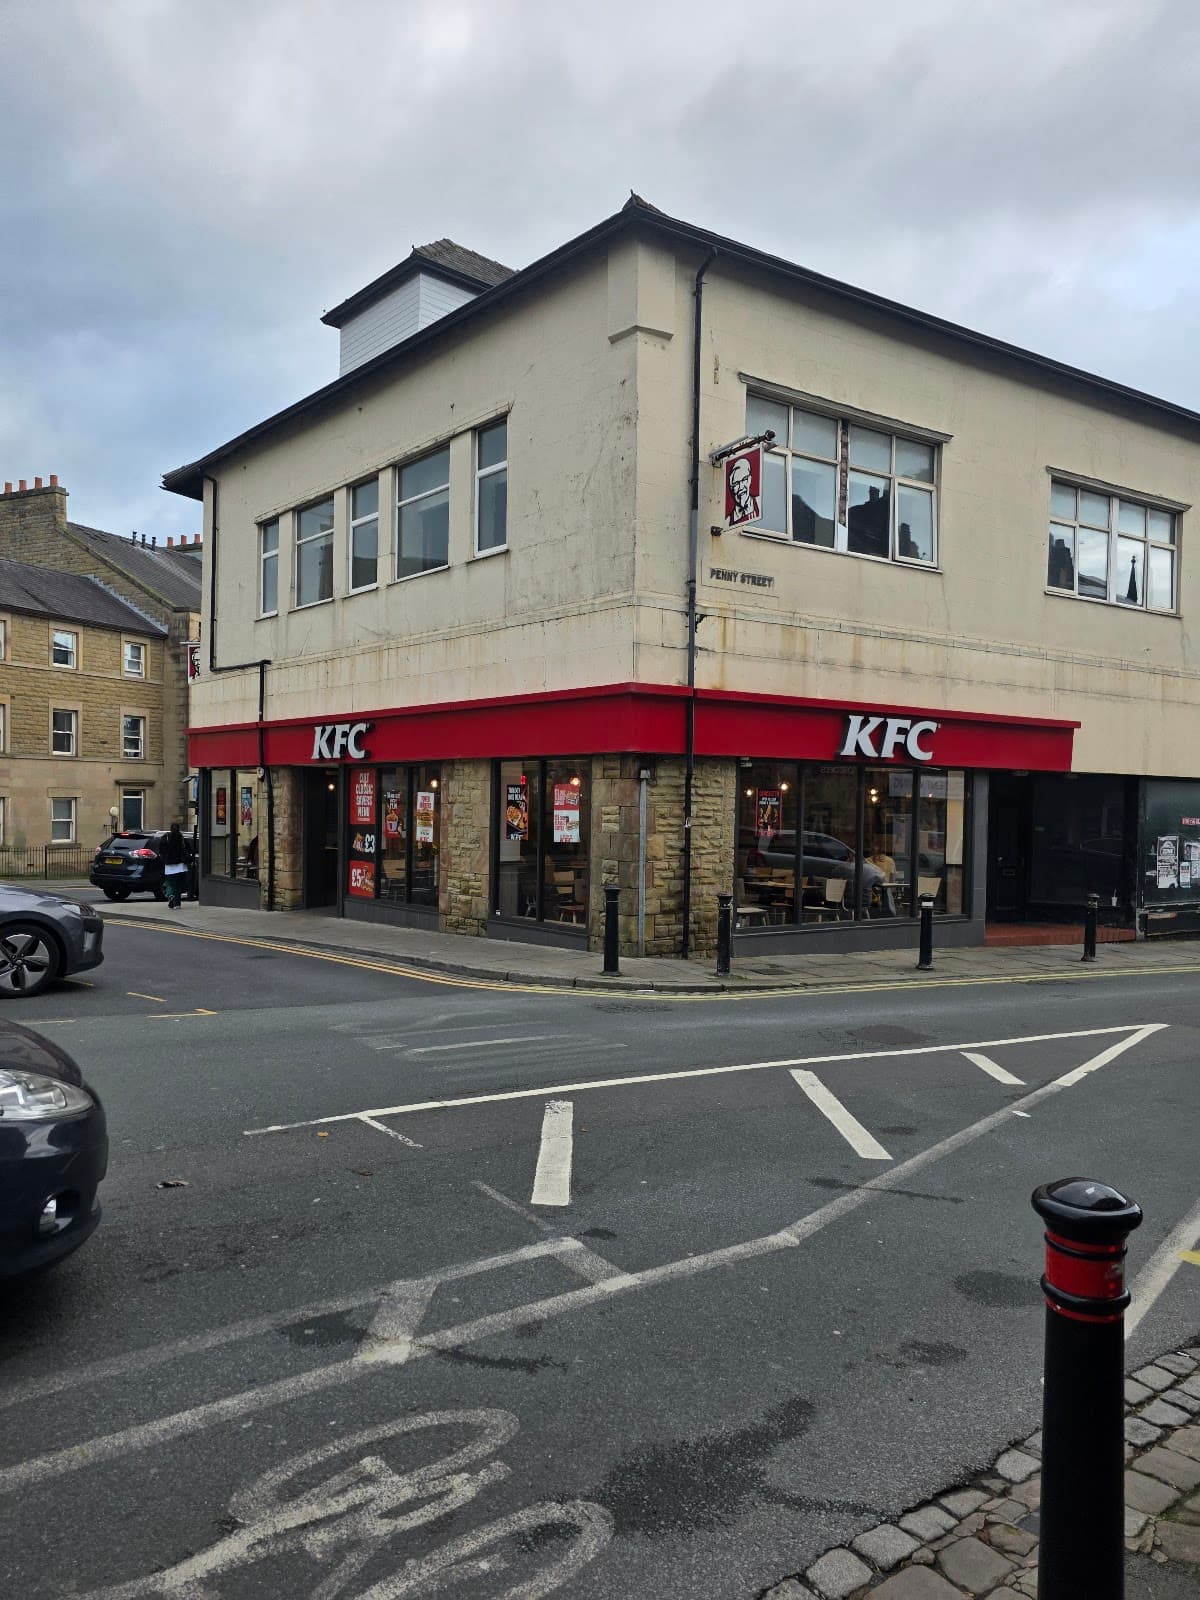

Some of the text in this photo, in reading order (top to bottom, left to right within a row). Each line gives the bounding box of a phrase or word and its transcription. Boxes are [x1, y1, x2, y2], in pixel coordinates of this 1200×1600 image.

[710, 568, 774, 588] PENNY STREET
[311, 723, 367, 759] KFC
[841, 715, 938, 760] KFC
[364, 834, 376, 853] £3
[351, 868, 361, 888] £5
